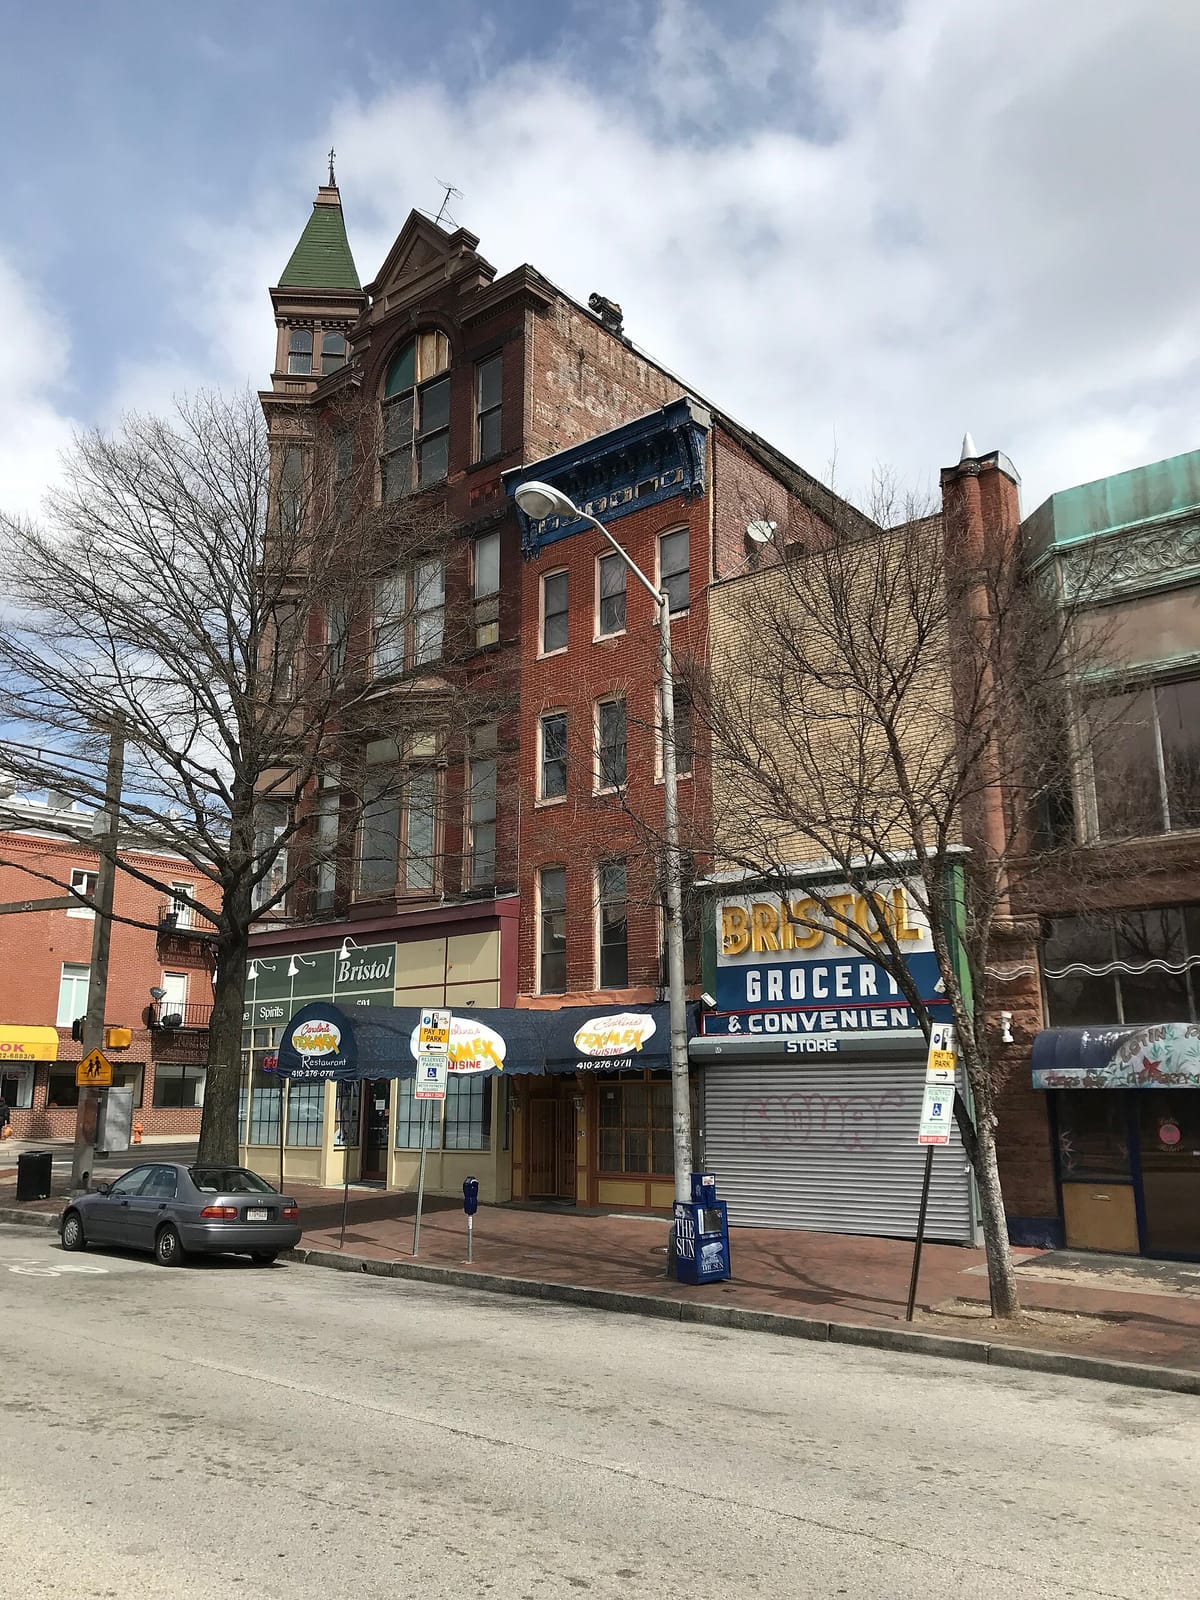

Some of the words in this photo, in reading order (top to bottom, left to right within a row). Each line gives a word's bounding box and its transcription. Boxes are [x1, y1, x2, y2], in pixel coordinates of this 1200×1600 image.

[721, 888, 923, 955] BRISTOL
[336, 956, 393, 983] Bristol
[259, 1006, 284, 1020] Spirits
[727, 1015, 742, 1033] &
[787, 1039, 838, 1053] STORE
[301, 1054, 347, 1069] Restaurant
[933, 1051, 945, 1059] PAY
[946, 1052, 954, 1060] TO
[447, 1060, 481, 1069] UISINE
[576, 1059, 632, 1070] 410-276-0711
[934, 1060, 951, 1068] PARK
[675, 1218, 695, 1239] THE
[676, 1237, 695, 1258] SUN
